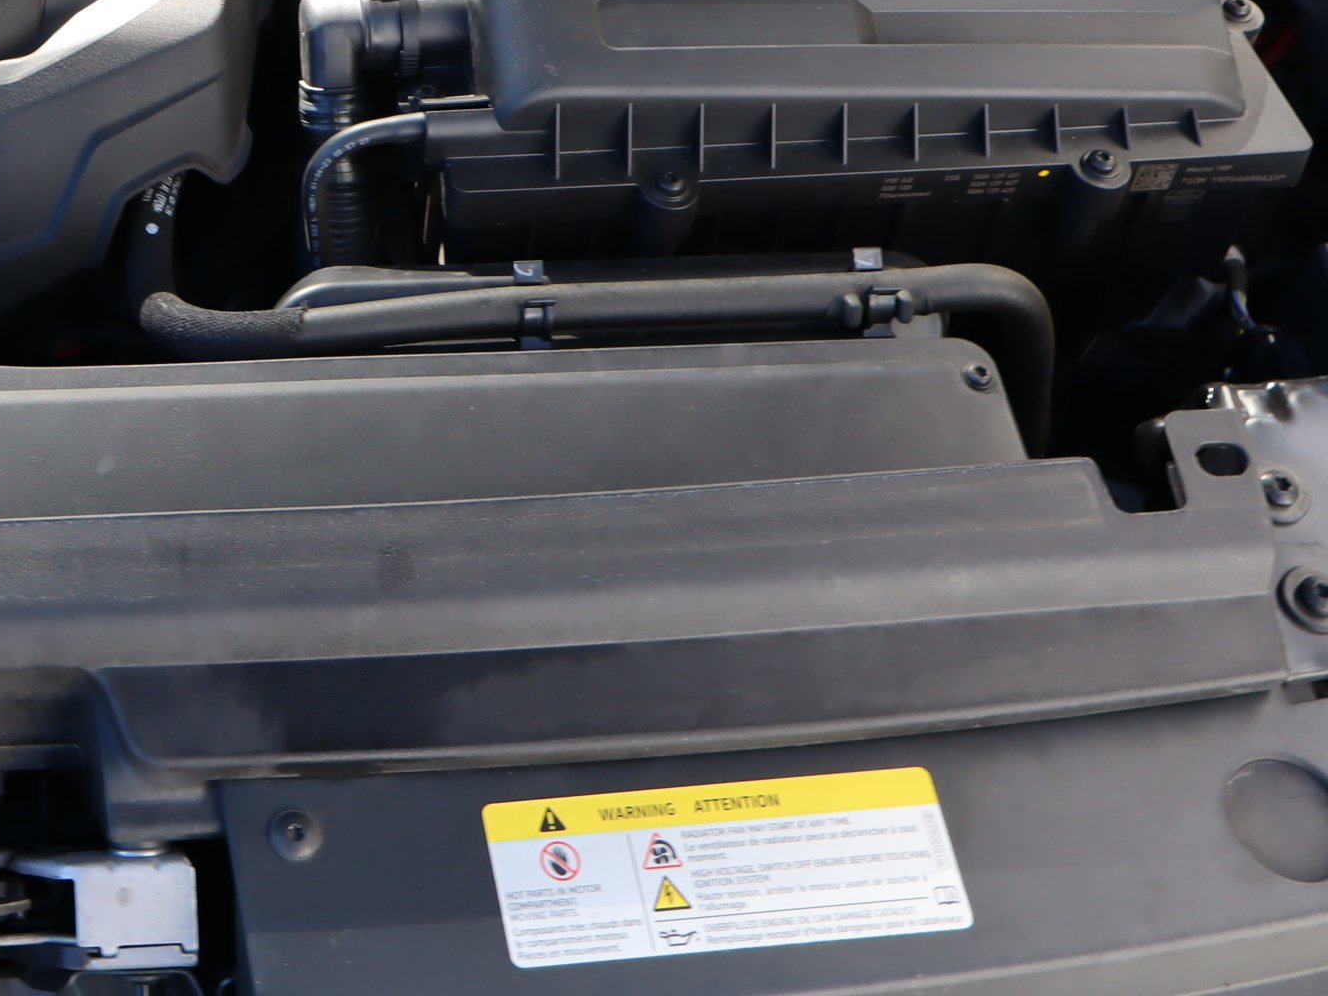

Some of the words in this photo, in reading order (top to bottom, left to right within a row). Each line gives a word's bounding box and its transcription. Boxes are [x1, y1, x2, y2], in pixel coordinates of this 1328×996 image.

[598, 802, 676, 822] WARNING
[694, 793, 781, 814] ATTENTION
[681, 827, 725, 839] RADIATOR
[727, 825, 744, 835] FAN
[747, 824, 766, 834] MAY
[768, 821, 794, 832] START
